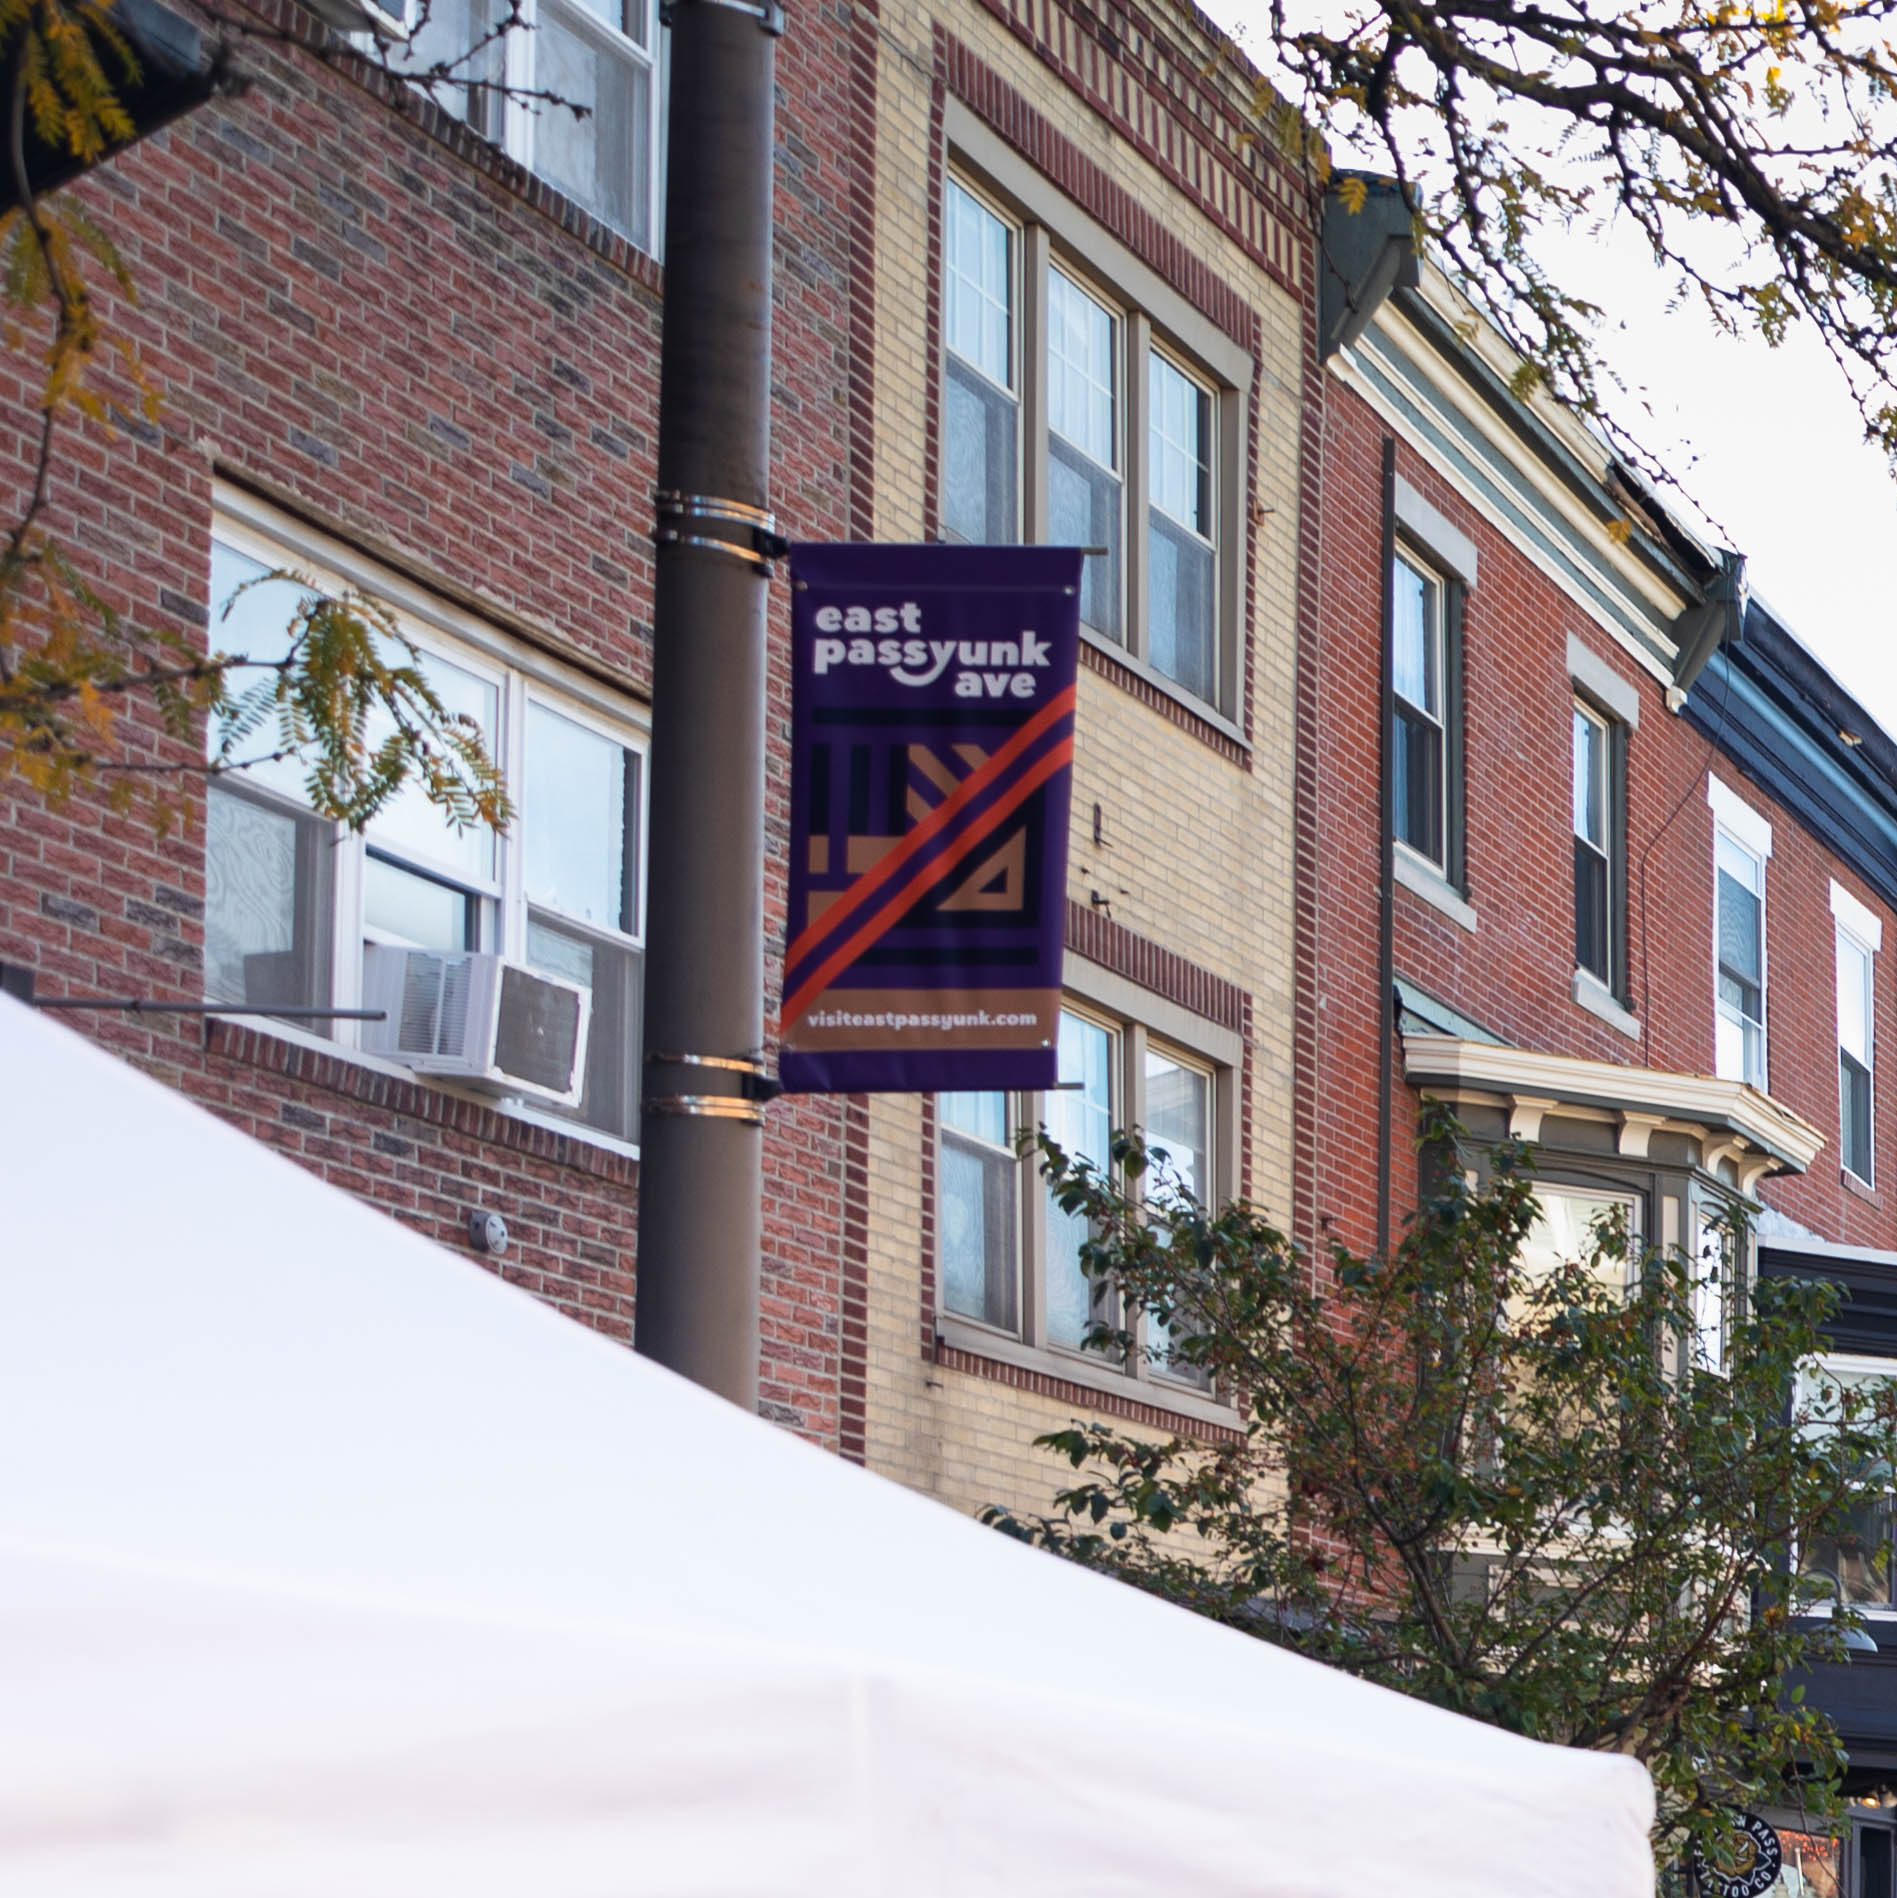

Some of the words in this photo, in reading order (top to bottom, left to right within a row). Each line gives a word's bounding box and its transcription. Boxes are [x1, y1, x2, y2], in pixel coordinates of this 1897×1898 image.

[814, 602, 922, 634] east
[812, 630, 1052, 687] passyunk
[954, 671, 1037, 698] ave
[808, 1010, 1038, 1031] visiteastpassyunk.com
[1752, 1820, 1779, 1857] PASS
